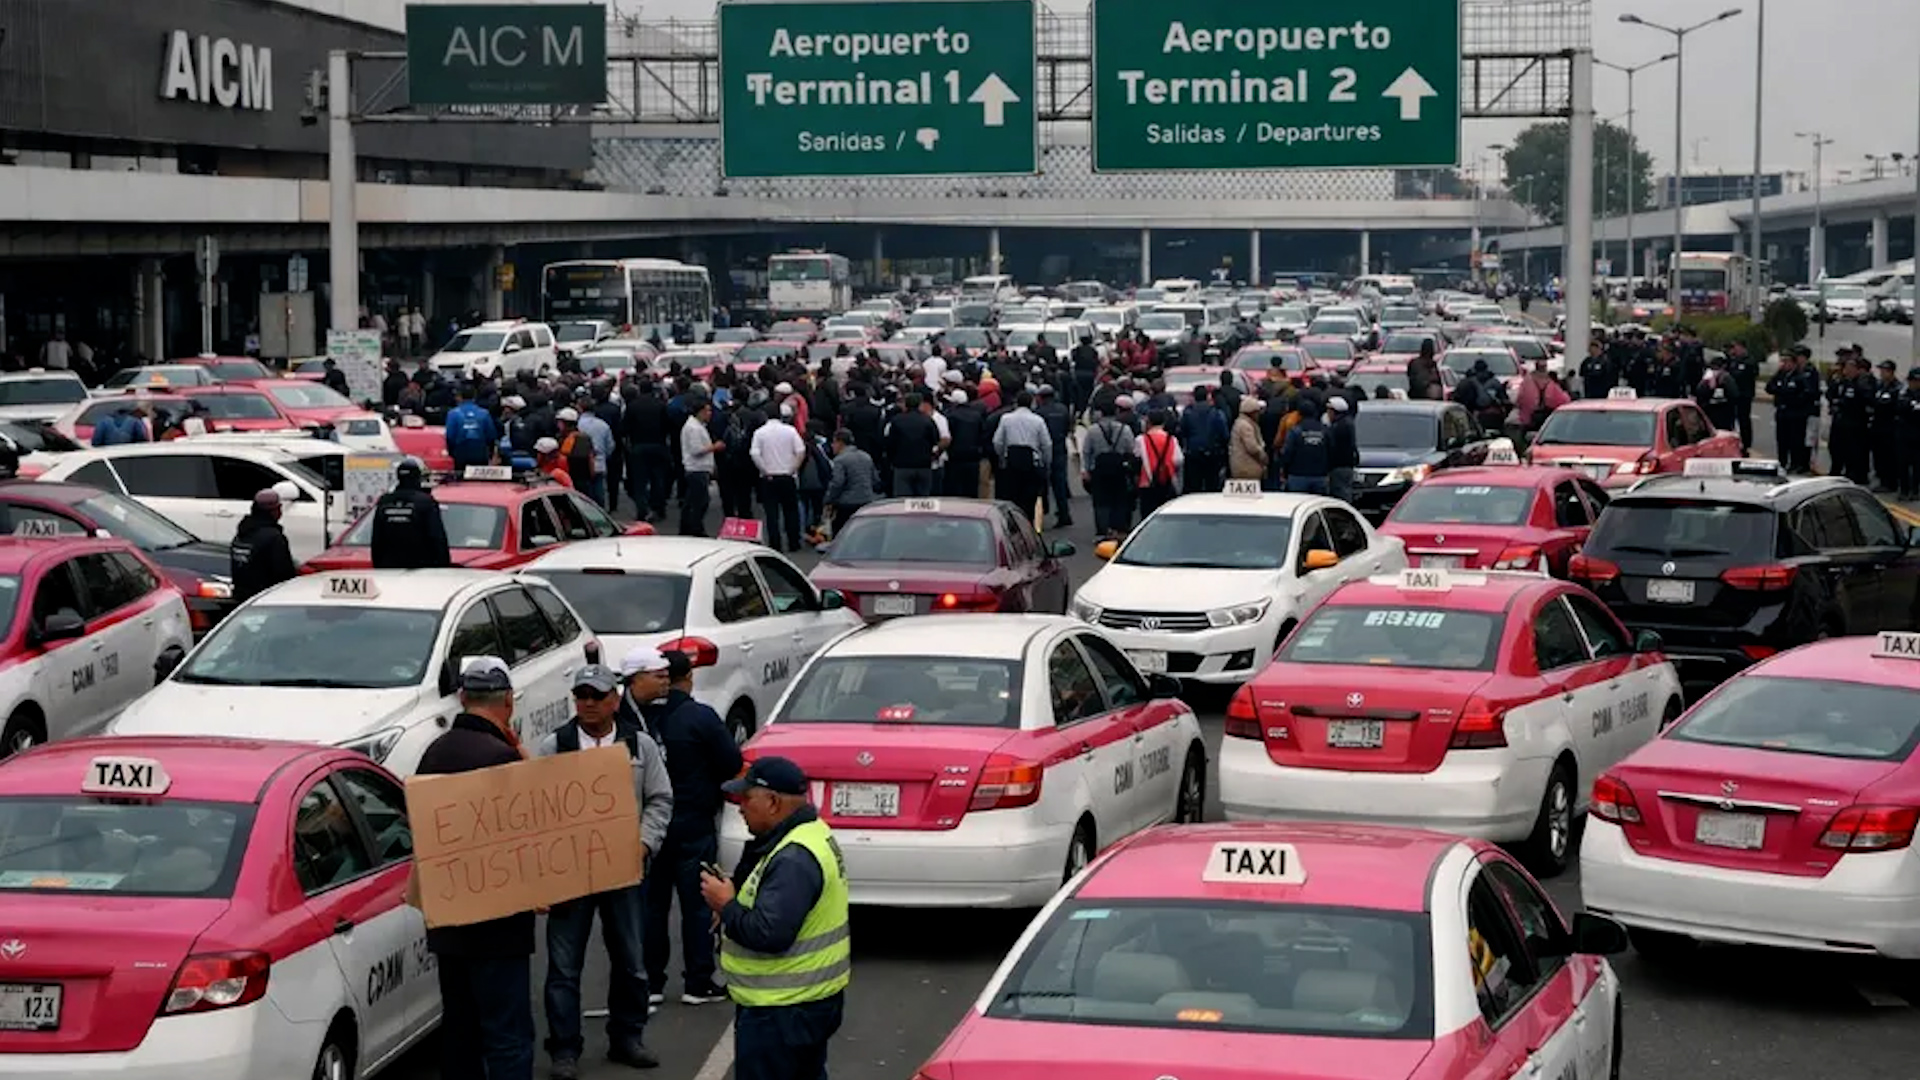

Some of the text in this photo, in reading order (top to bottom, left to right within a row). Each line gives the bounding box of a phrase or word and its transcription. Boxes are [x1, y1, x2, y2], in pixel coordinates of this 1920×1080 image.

[768, 26, 970, 62] Aeropuerto
[1162, 20, 1391, 59] Aeropuerto
[163, 28, 273, 111] AICM
[746, 69, 960, 105] Terminal 1
[1117, 67, 1357, 105] Terminal 2
[1146, 123, 1226, 144] Salidas
[1256, 121, 1382, 146] Departures
[1229, 482, 1257, 494] TAXI
[330, 578, 367, 594] TAXI
[1405, 572, 1439, 588] TAXI
[95, 762, 153, 788] TAXI
[435, 828, 612, 901] JUSTICIA
[1221, 847, 1286, 876] TAXI
